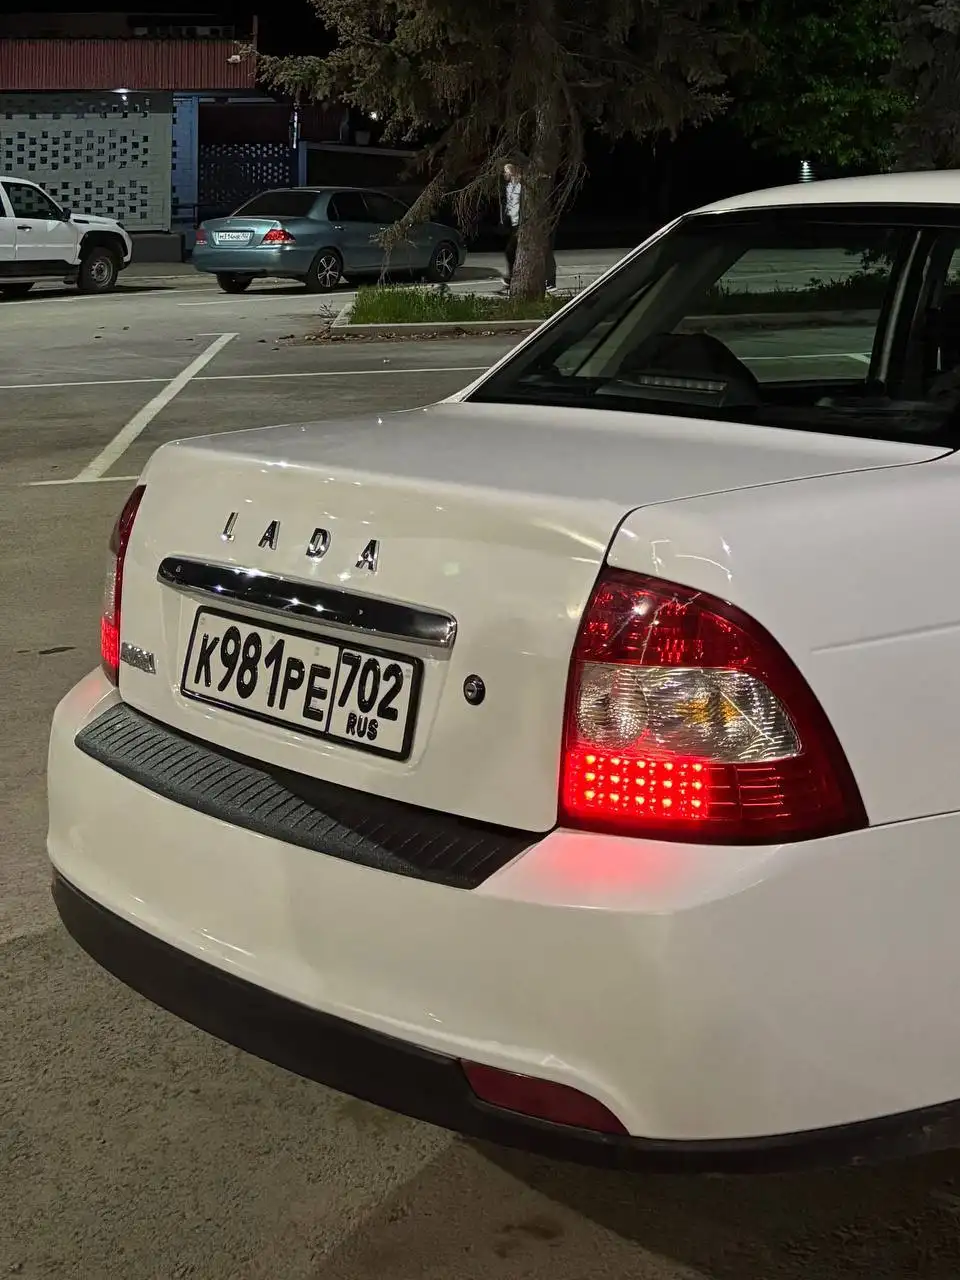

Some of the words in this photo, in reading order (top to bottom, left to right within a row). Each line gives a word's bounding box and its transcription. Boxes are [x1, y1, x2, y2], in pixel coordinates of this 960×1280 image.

[219, 511, 380, 572] LADA
[338, 651, 404, 722] 702
[346, 712, 379, 741] RUS
